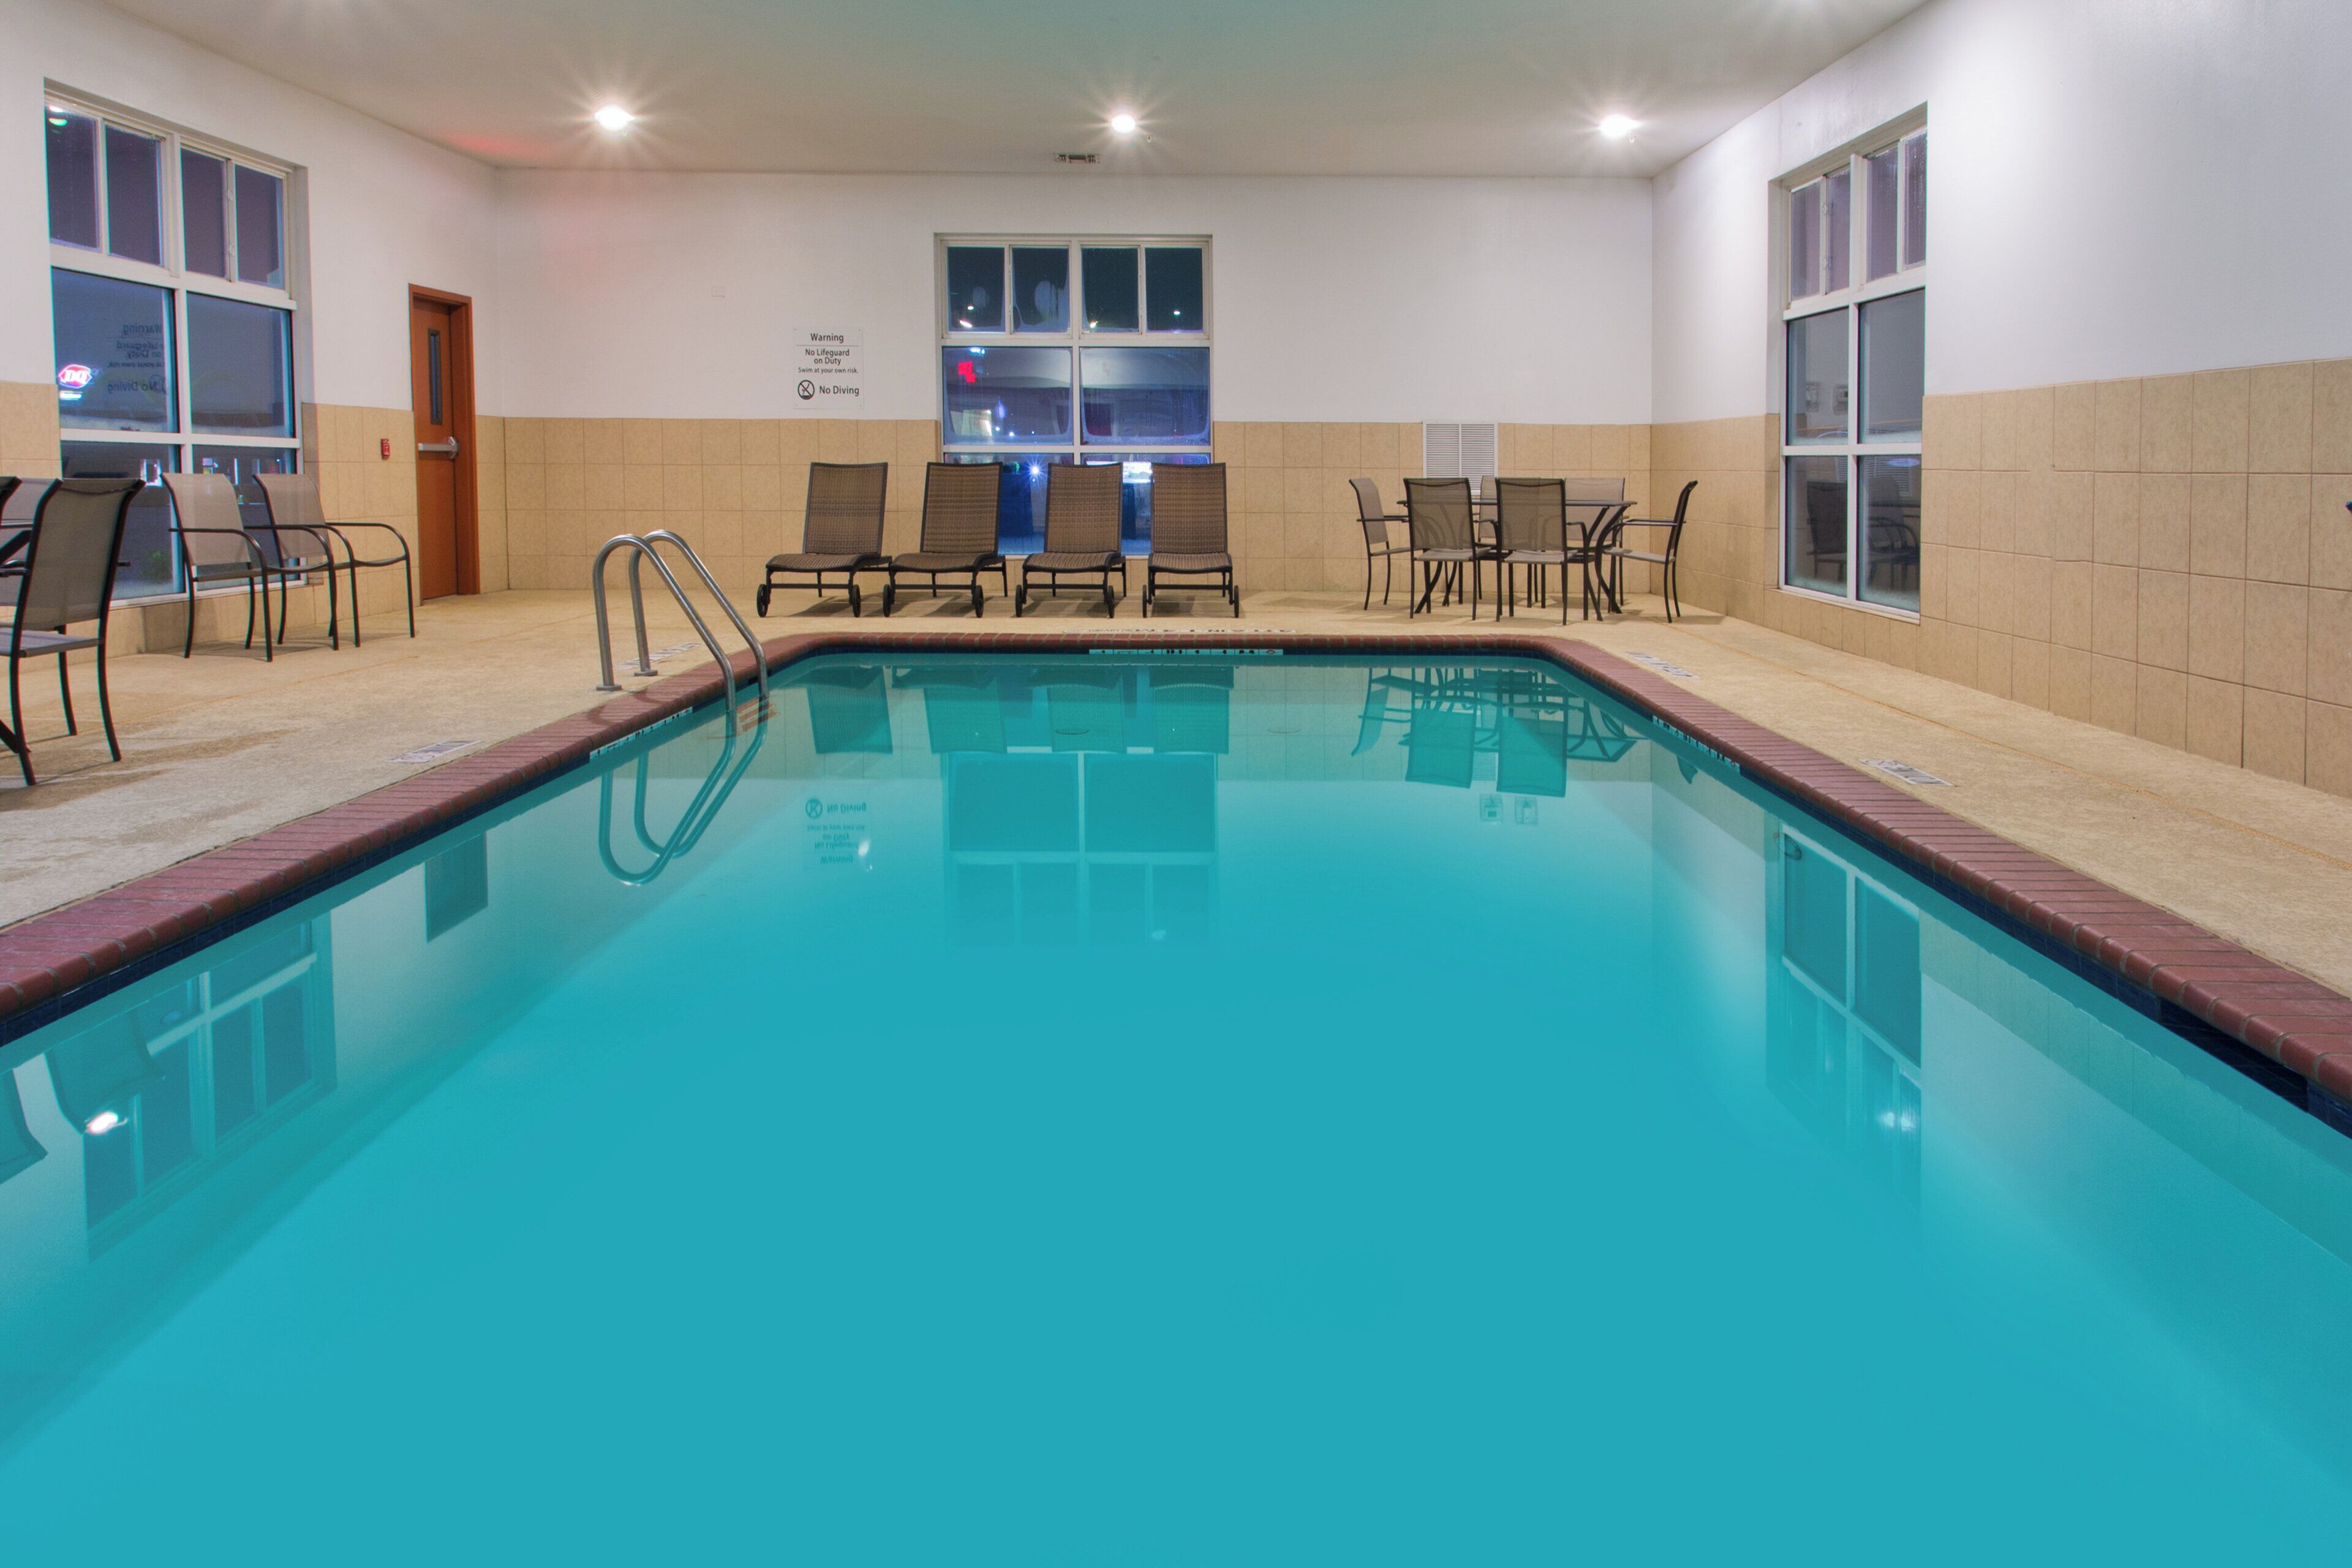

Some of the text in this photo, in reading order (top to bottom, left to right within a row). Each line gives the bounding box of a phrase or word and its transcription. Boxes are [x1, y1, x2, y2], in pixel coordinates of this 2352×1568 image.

[810, 333, 844, 344] Warning
[816, 349, 850, 358] Lifeguard
[824, 357, 842, 366] Duty
[64, 369, 88, 383] DQ
[820, 385, 859, 396] No Diving
